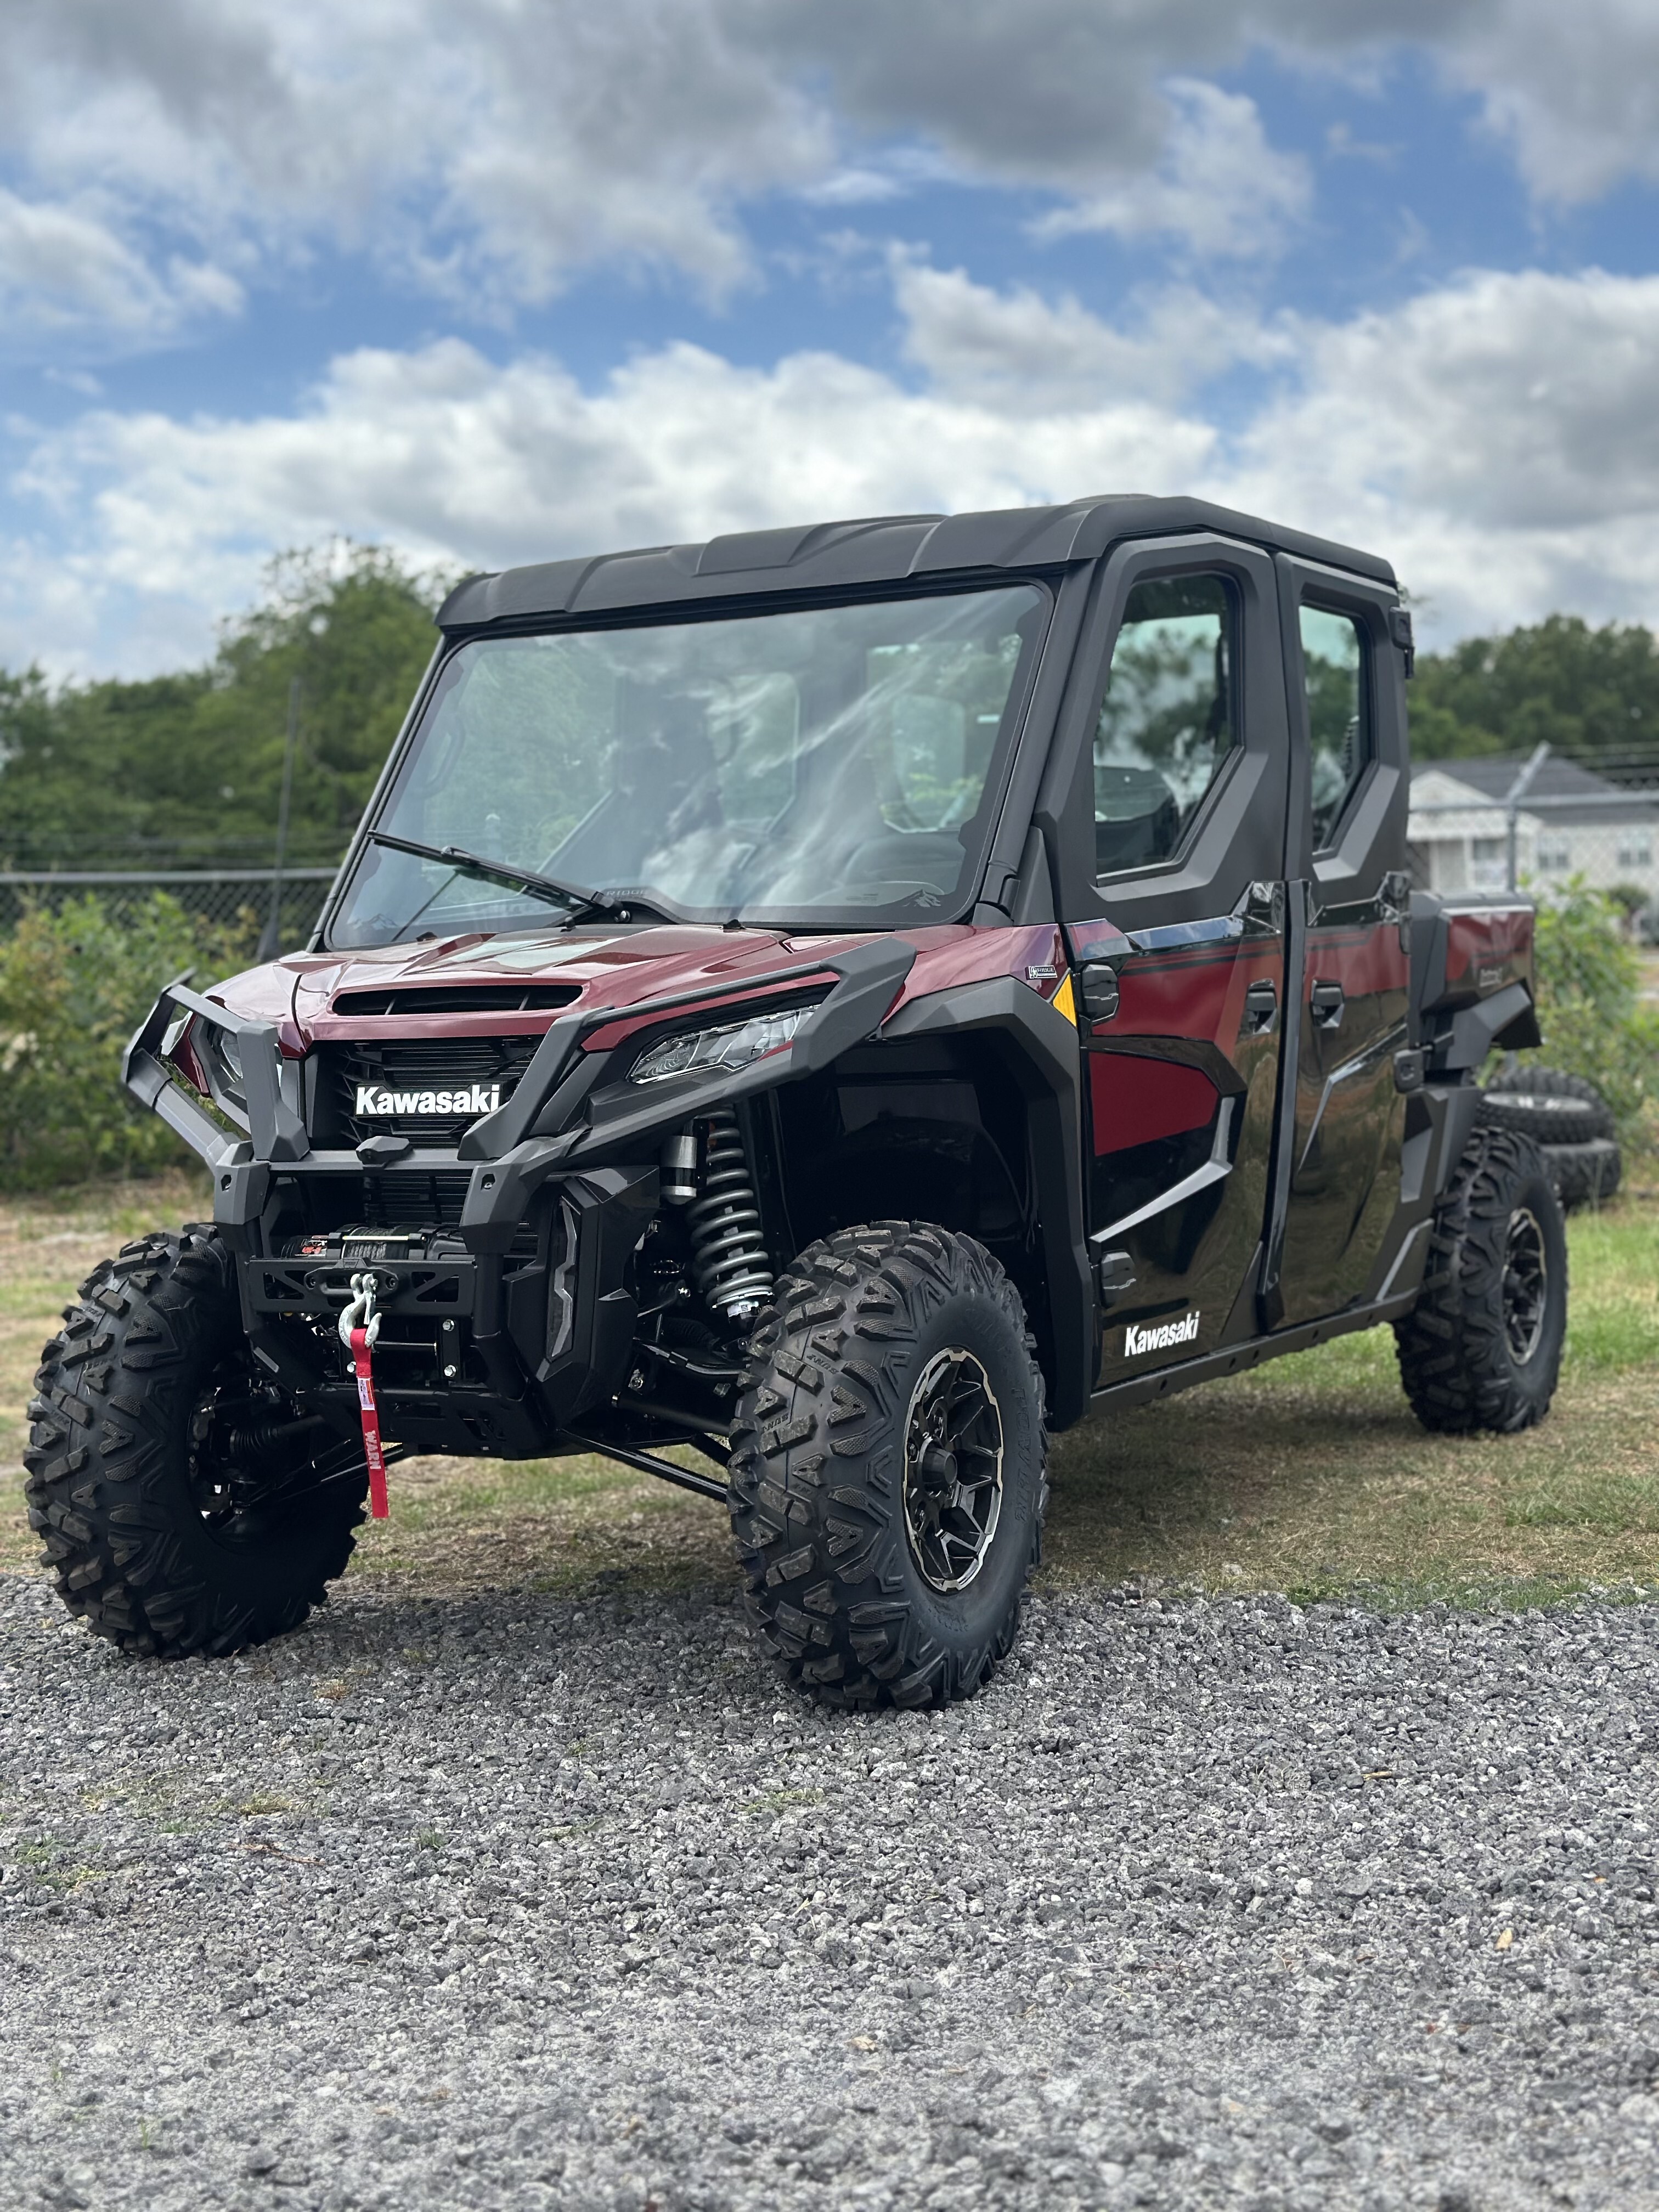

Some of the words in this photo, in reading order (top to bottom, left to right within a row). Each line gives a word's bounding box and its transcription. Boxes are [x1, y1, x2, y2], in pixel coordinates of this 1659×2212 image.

[356, 1084, 499, 1114] Kawasaki
[1125, 1311, 1200, 1357] Kawasaki
[364, 1430, 381, 1469] WARN
